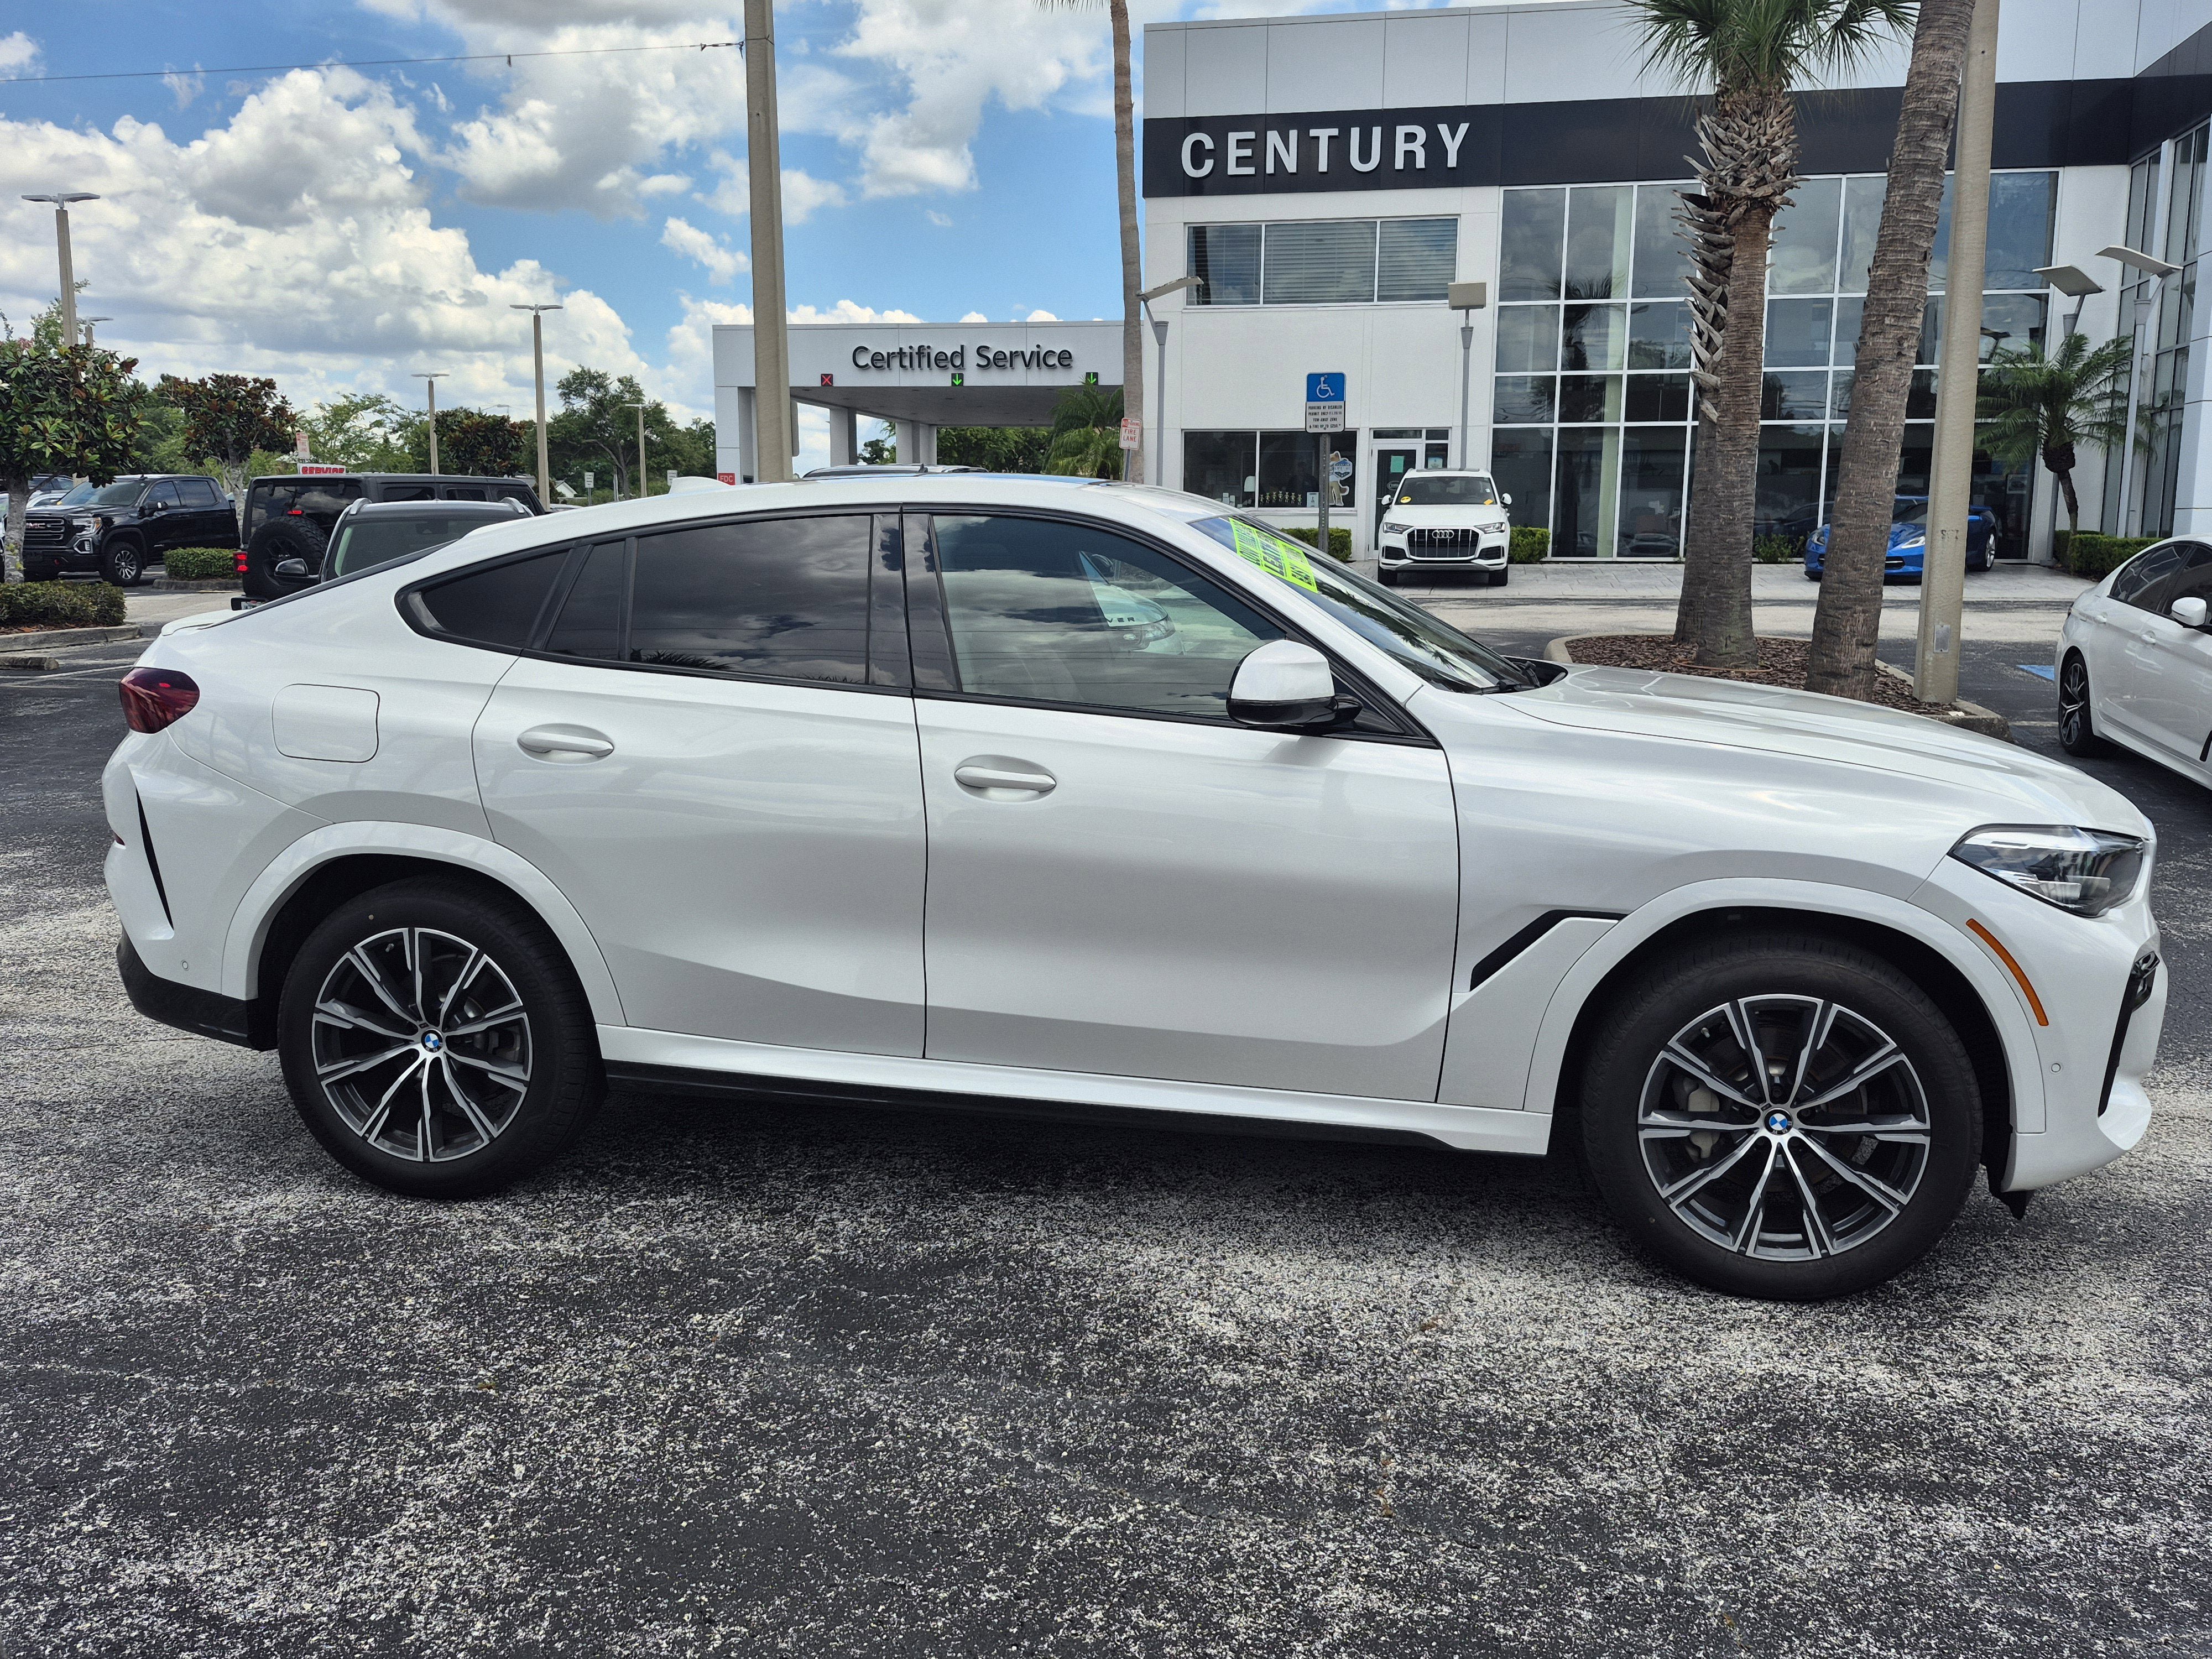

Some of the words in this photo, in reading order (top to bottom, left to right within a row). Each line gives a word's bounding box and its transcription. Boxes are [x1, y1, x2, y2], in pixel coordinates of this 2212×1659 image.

[1181, 122, 1469, 178] CENTURY
[852, 344, 966, 371] Certified
[975, 344, 1073, 369] Service
